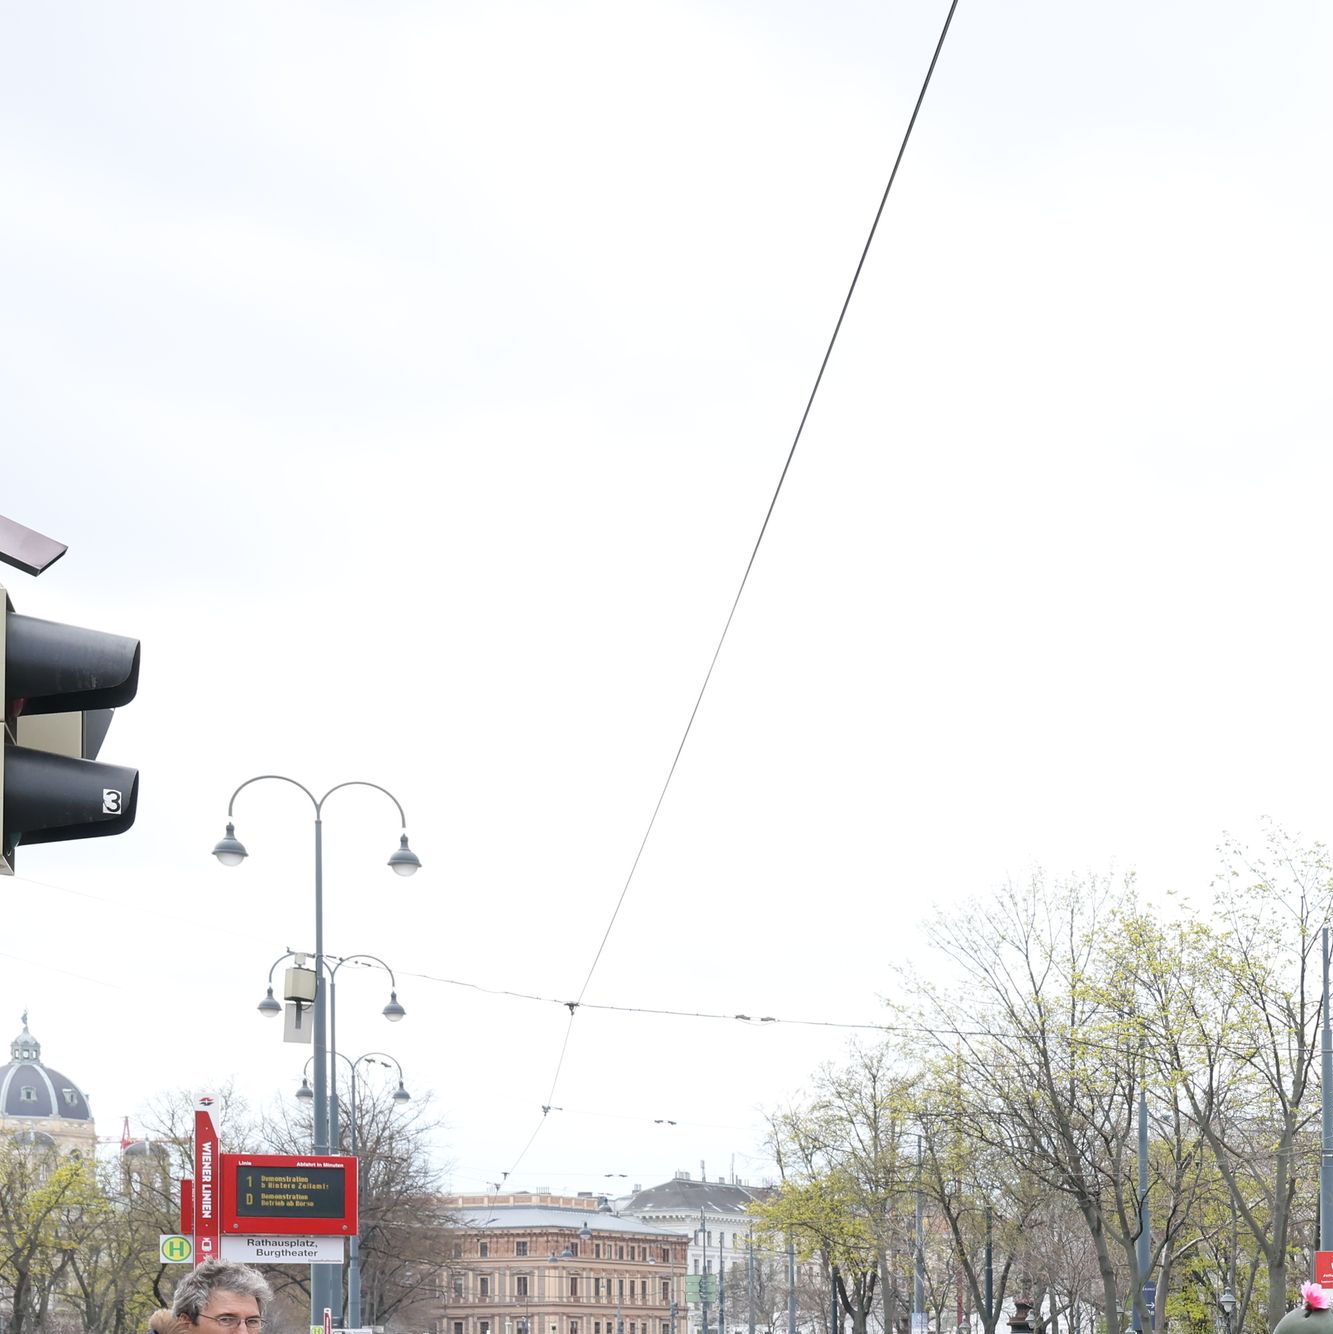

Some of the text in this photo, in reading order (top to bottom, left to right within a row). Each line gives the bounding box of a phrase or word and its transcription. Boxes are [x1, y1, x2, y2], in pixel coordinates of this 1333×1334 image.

[105, 790, 120, 812] 3
[202, 1142, 211, 1218] WIENER LINIEN
[169, 1242, 184, 1256] H
[247, 1239, 318, 1249] Rathausplatz,
[256, 1249, 318, 1259] Burgtheater
